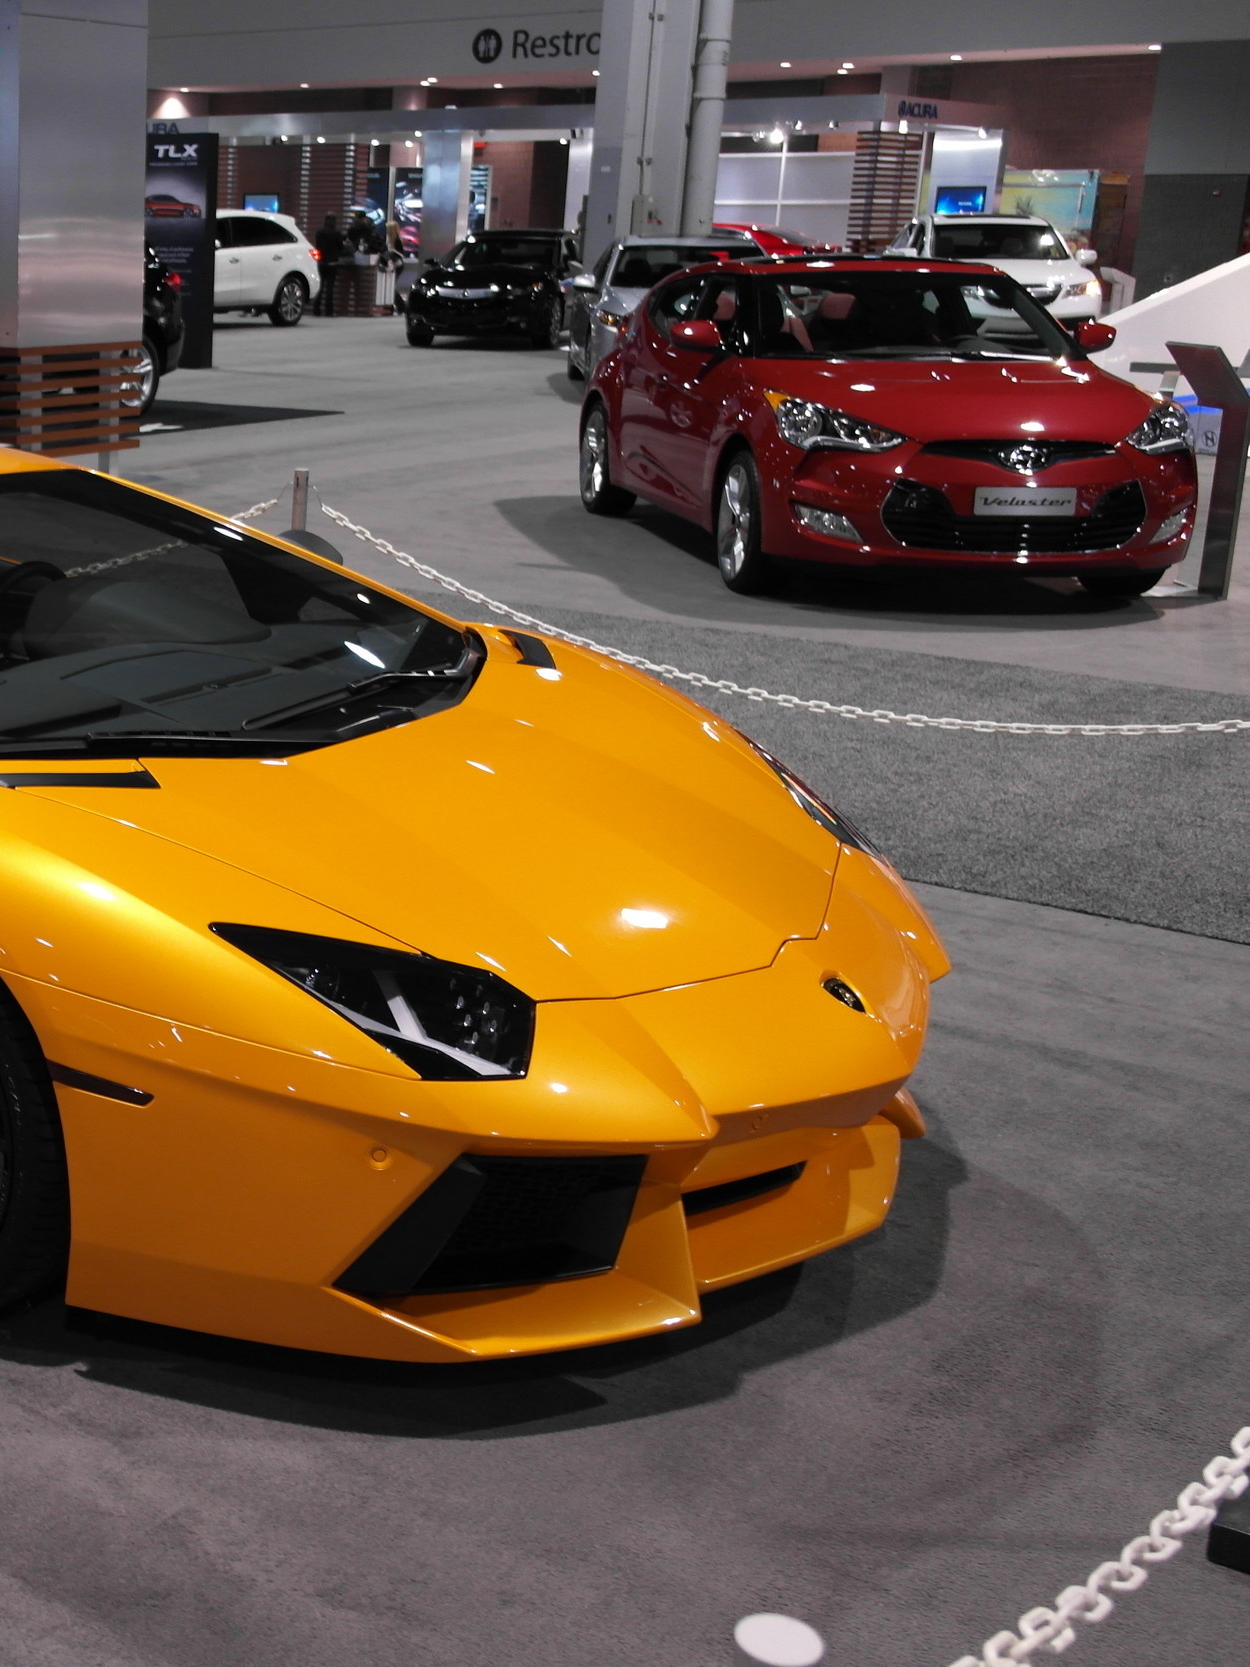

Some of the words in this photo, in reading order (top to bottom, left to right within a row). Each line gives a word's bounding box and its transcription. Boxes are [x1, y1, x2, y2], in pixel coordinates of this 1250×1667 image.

[908, 103, 938, 119] ACURA
[154, 144, 199, 158] TLX
[980, 497, 1072, 506] Veloster
